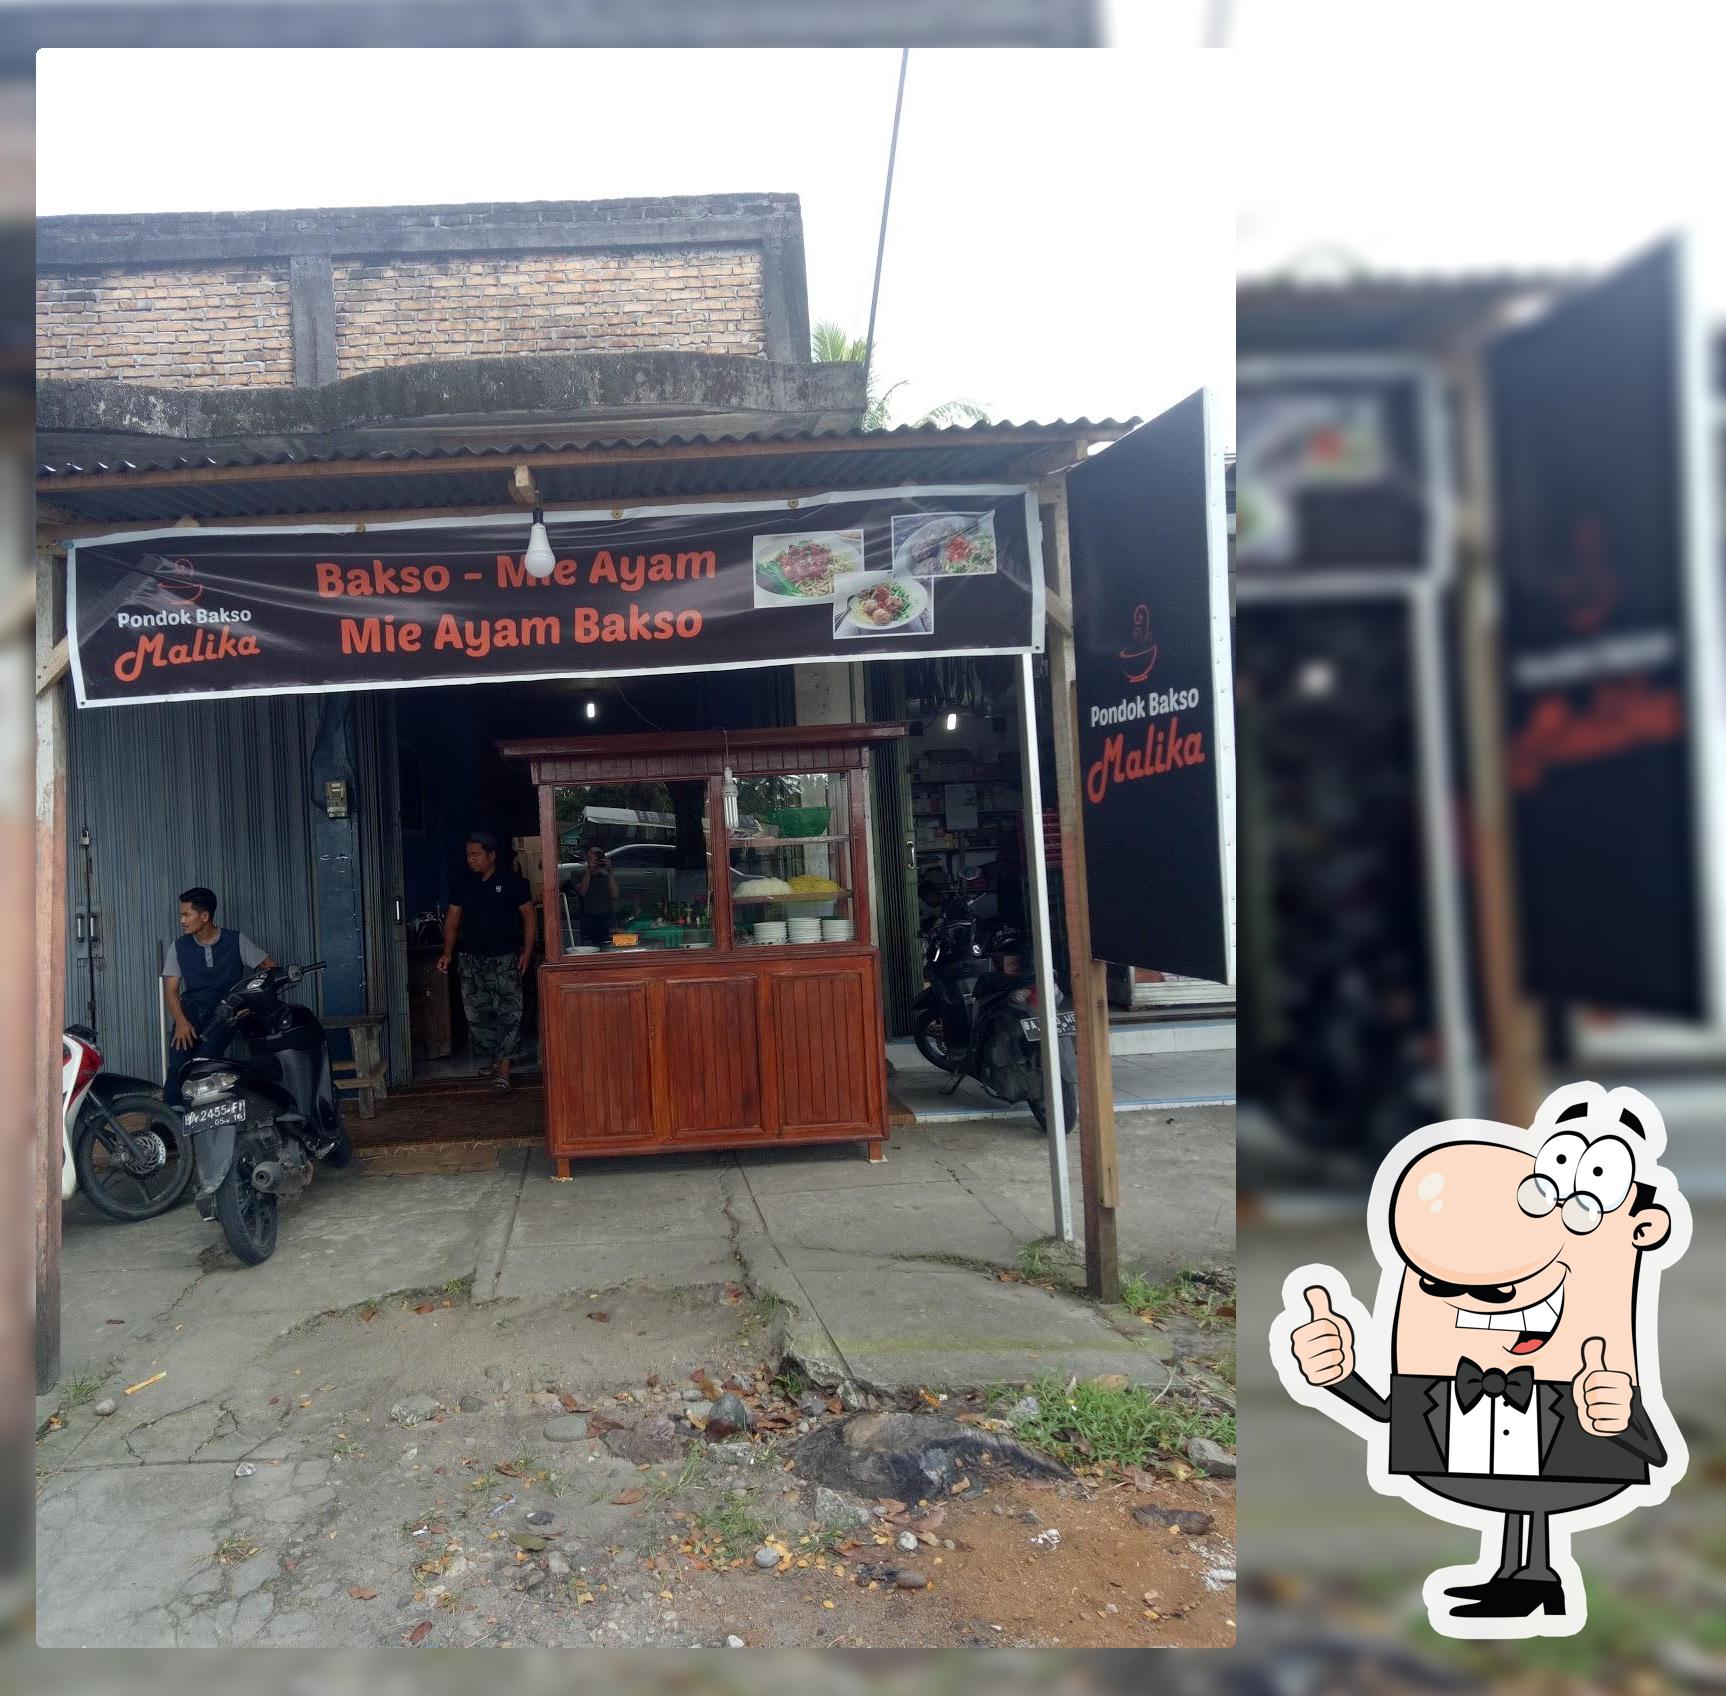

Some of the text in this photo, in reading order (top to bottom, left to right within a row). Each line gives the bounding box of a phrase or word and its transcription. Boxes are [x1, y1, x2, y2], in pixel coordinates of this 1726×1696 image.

[316, 559, 450, 598] Bakso
[496, 554, 577, 588] Me
[589, 551, 716, 592] Ayam
[117, 607, 252, 628] Pondok Bakso
[340, 603, 703, 658] Mie Ayam Bakso
[113, 626, 261, 682] Malika
[1090, 687, 1199, 728] Pondok Bakso
[1087, 716, 1206, 804] Malika
